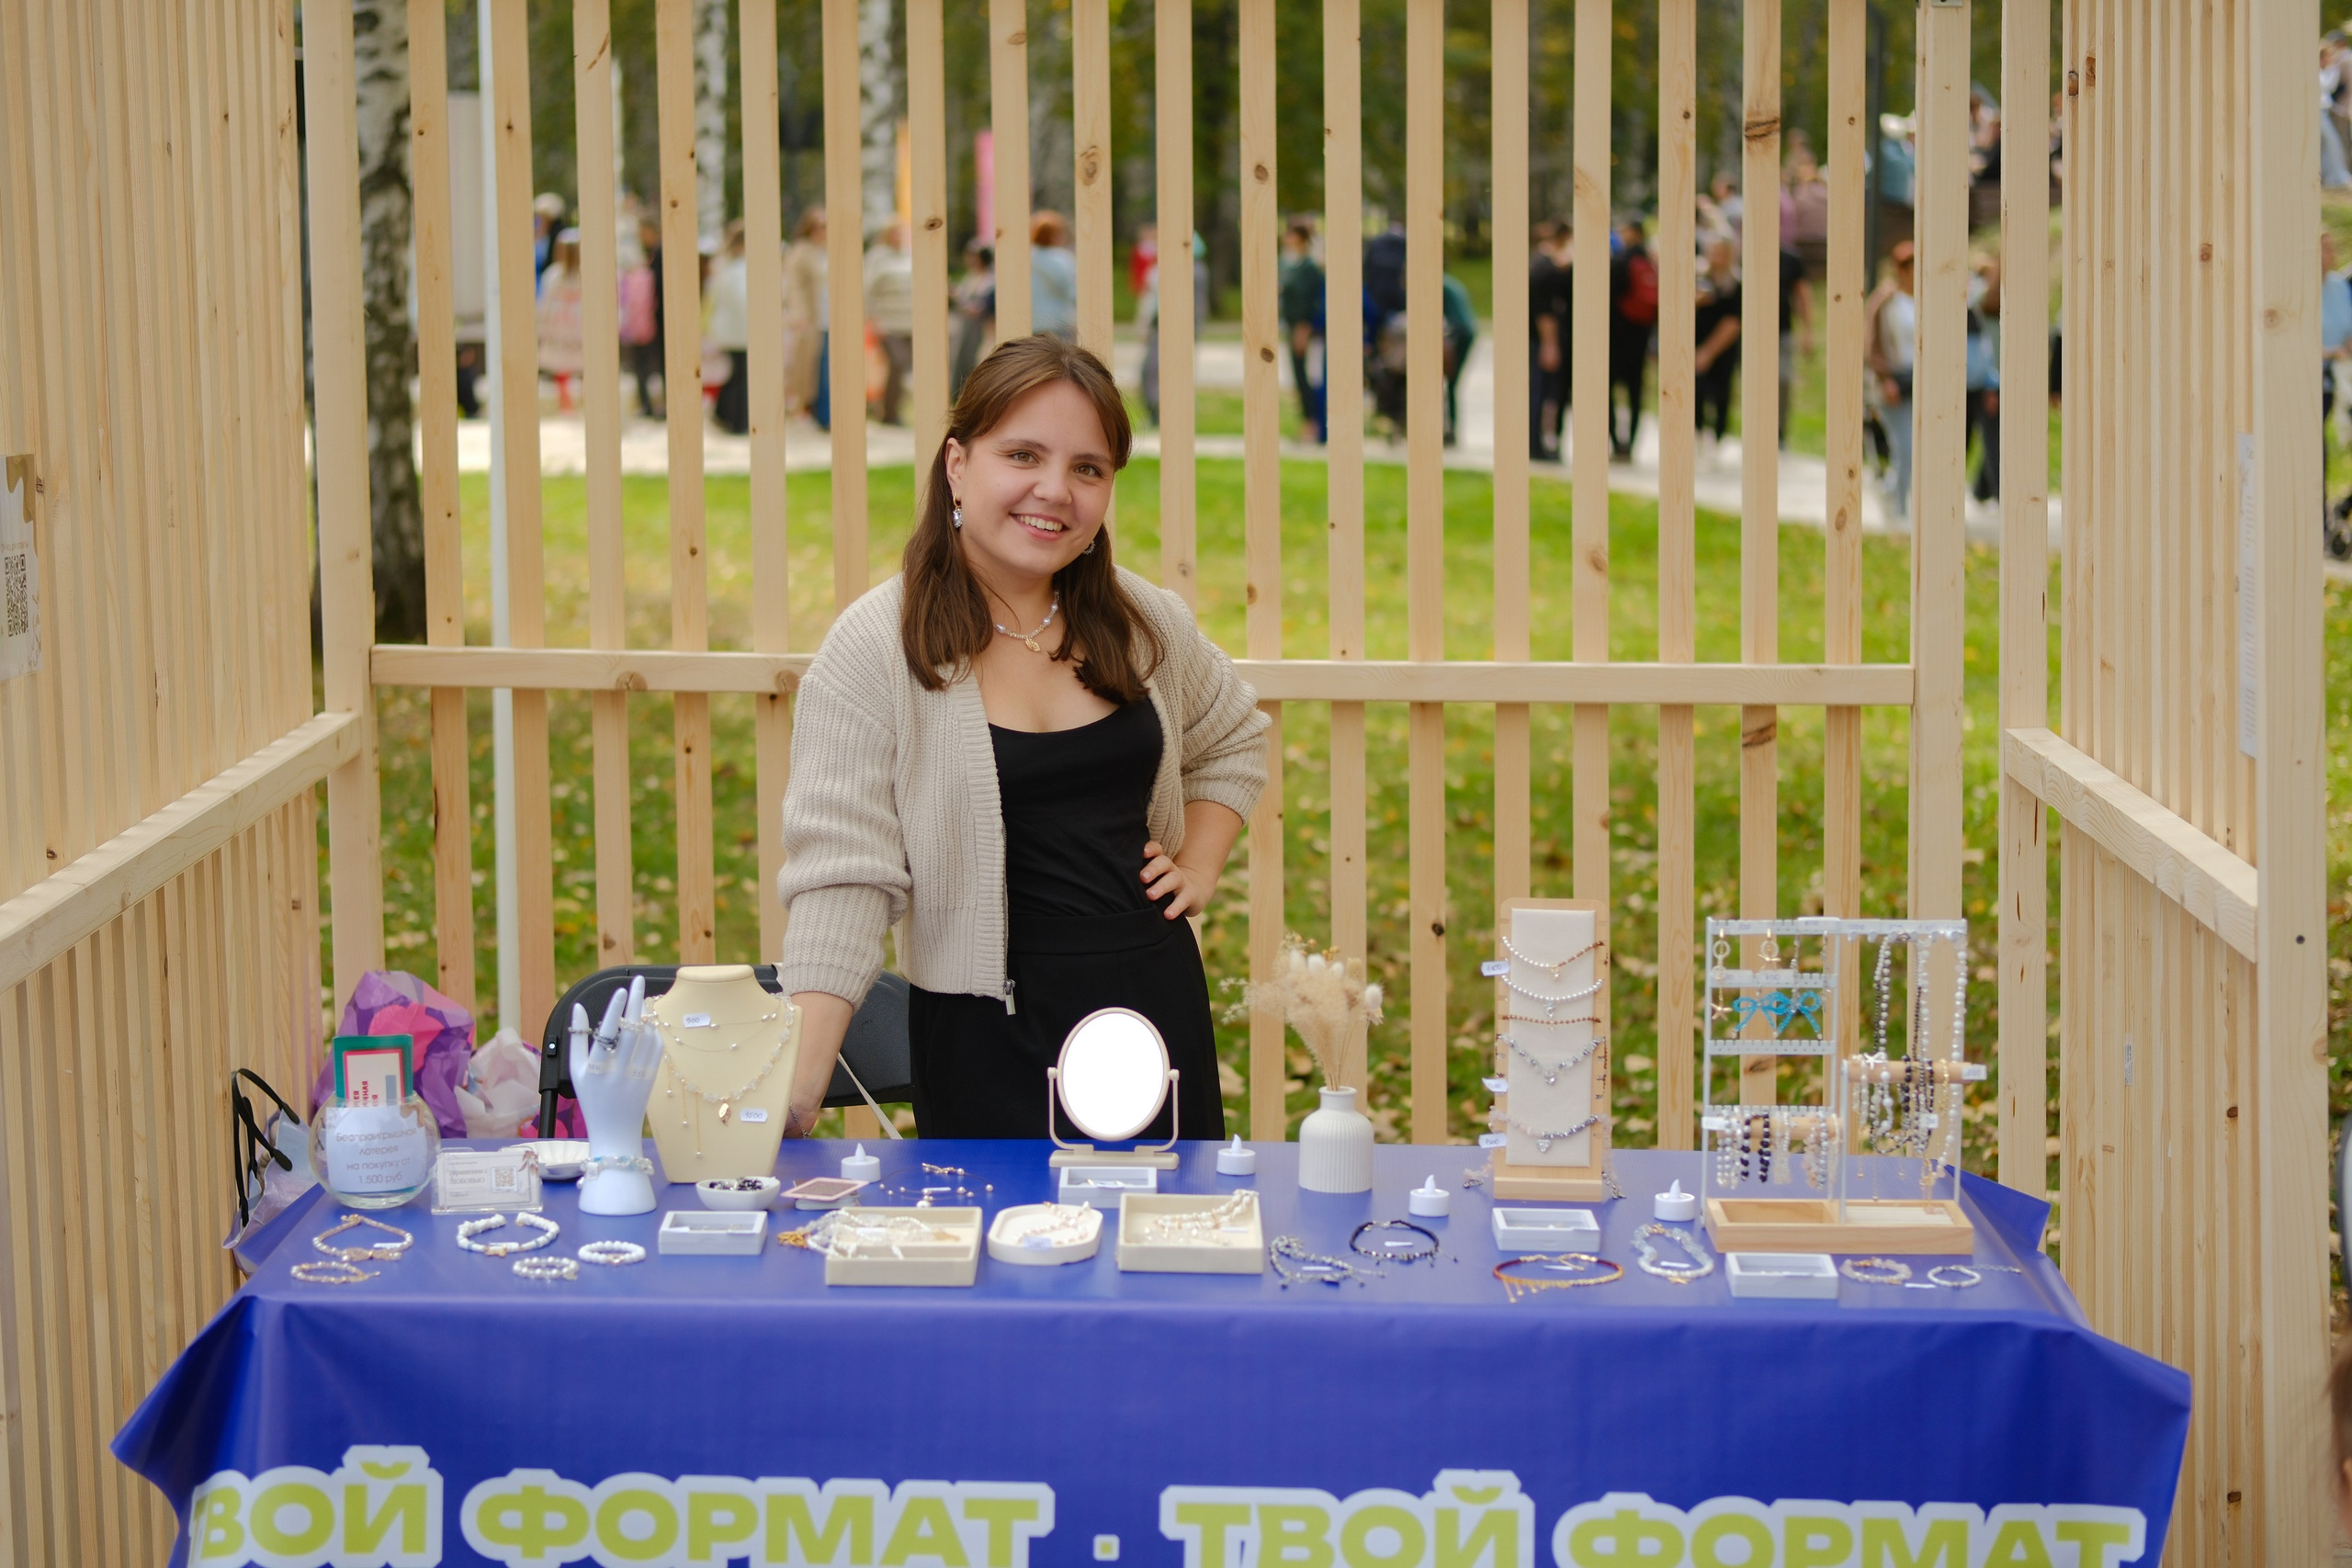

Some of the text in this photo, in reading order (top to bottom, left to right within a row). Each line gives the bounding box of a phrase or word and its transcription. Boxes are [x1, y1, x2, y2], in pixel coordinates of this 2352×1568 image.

[362, 1159, 400, 1170] покупку
[401, 1157, 411, 1167] от
[386, 1171, 402, 1184] руб
[475, 1466, 1040, 1568] ФОРМАТ
[1175, 1483, 1520, 1568] ТВОЙ
[1567, 1508, 2131, 1568] ФОРМАТ
